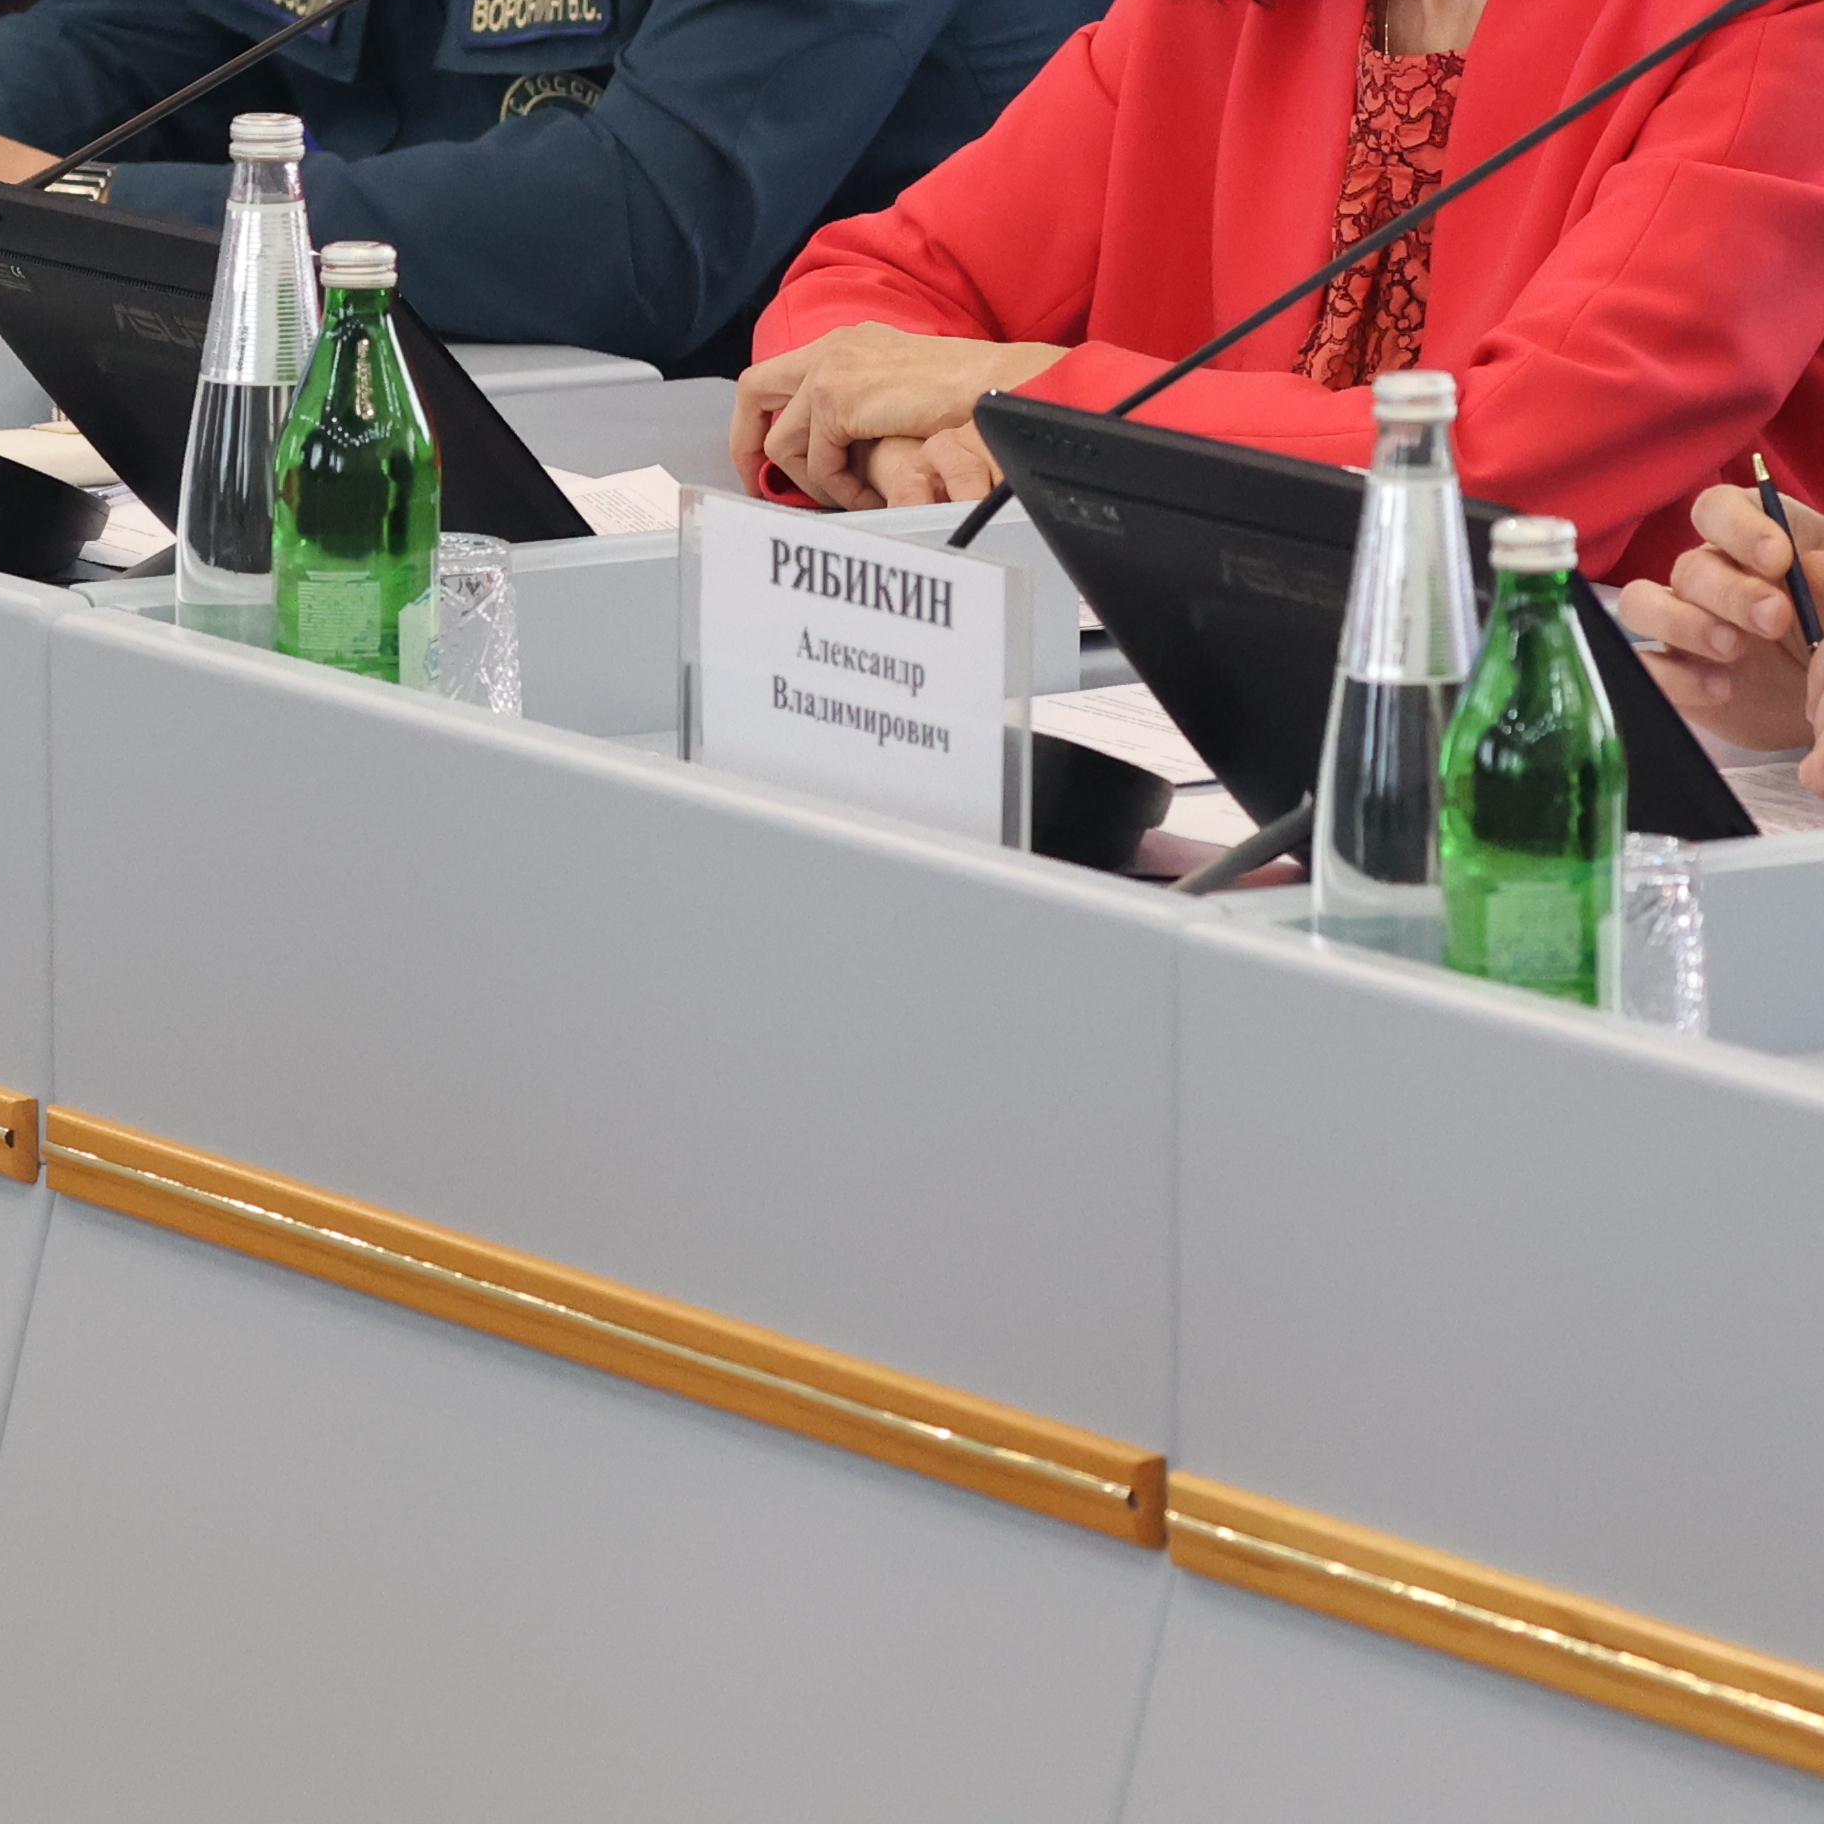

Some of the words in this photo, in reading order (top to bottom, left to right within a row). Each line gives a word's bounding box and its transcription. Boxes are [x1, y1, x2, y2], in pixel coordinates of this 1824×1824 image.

[769, 537, 955, 630] РЯБИКИН
[796, 625, 926, 698] Александр
[772, 674, 950, 753] Владимирович
